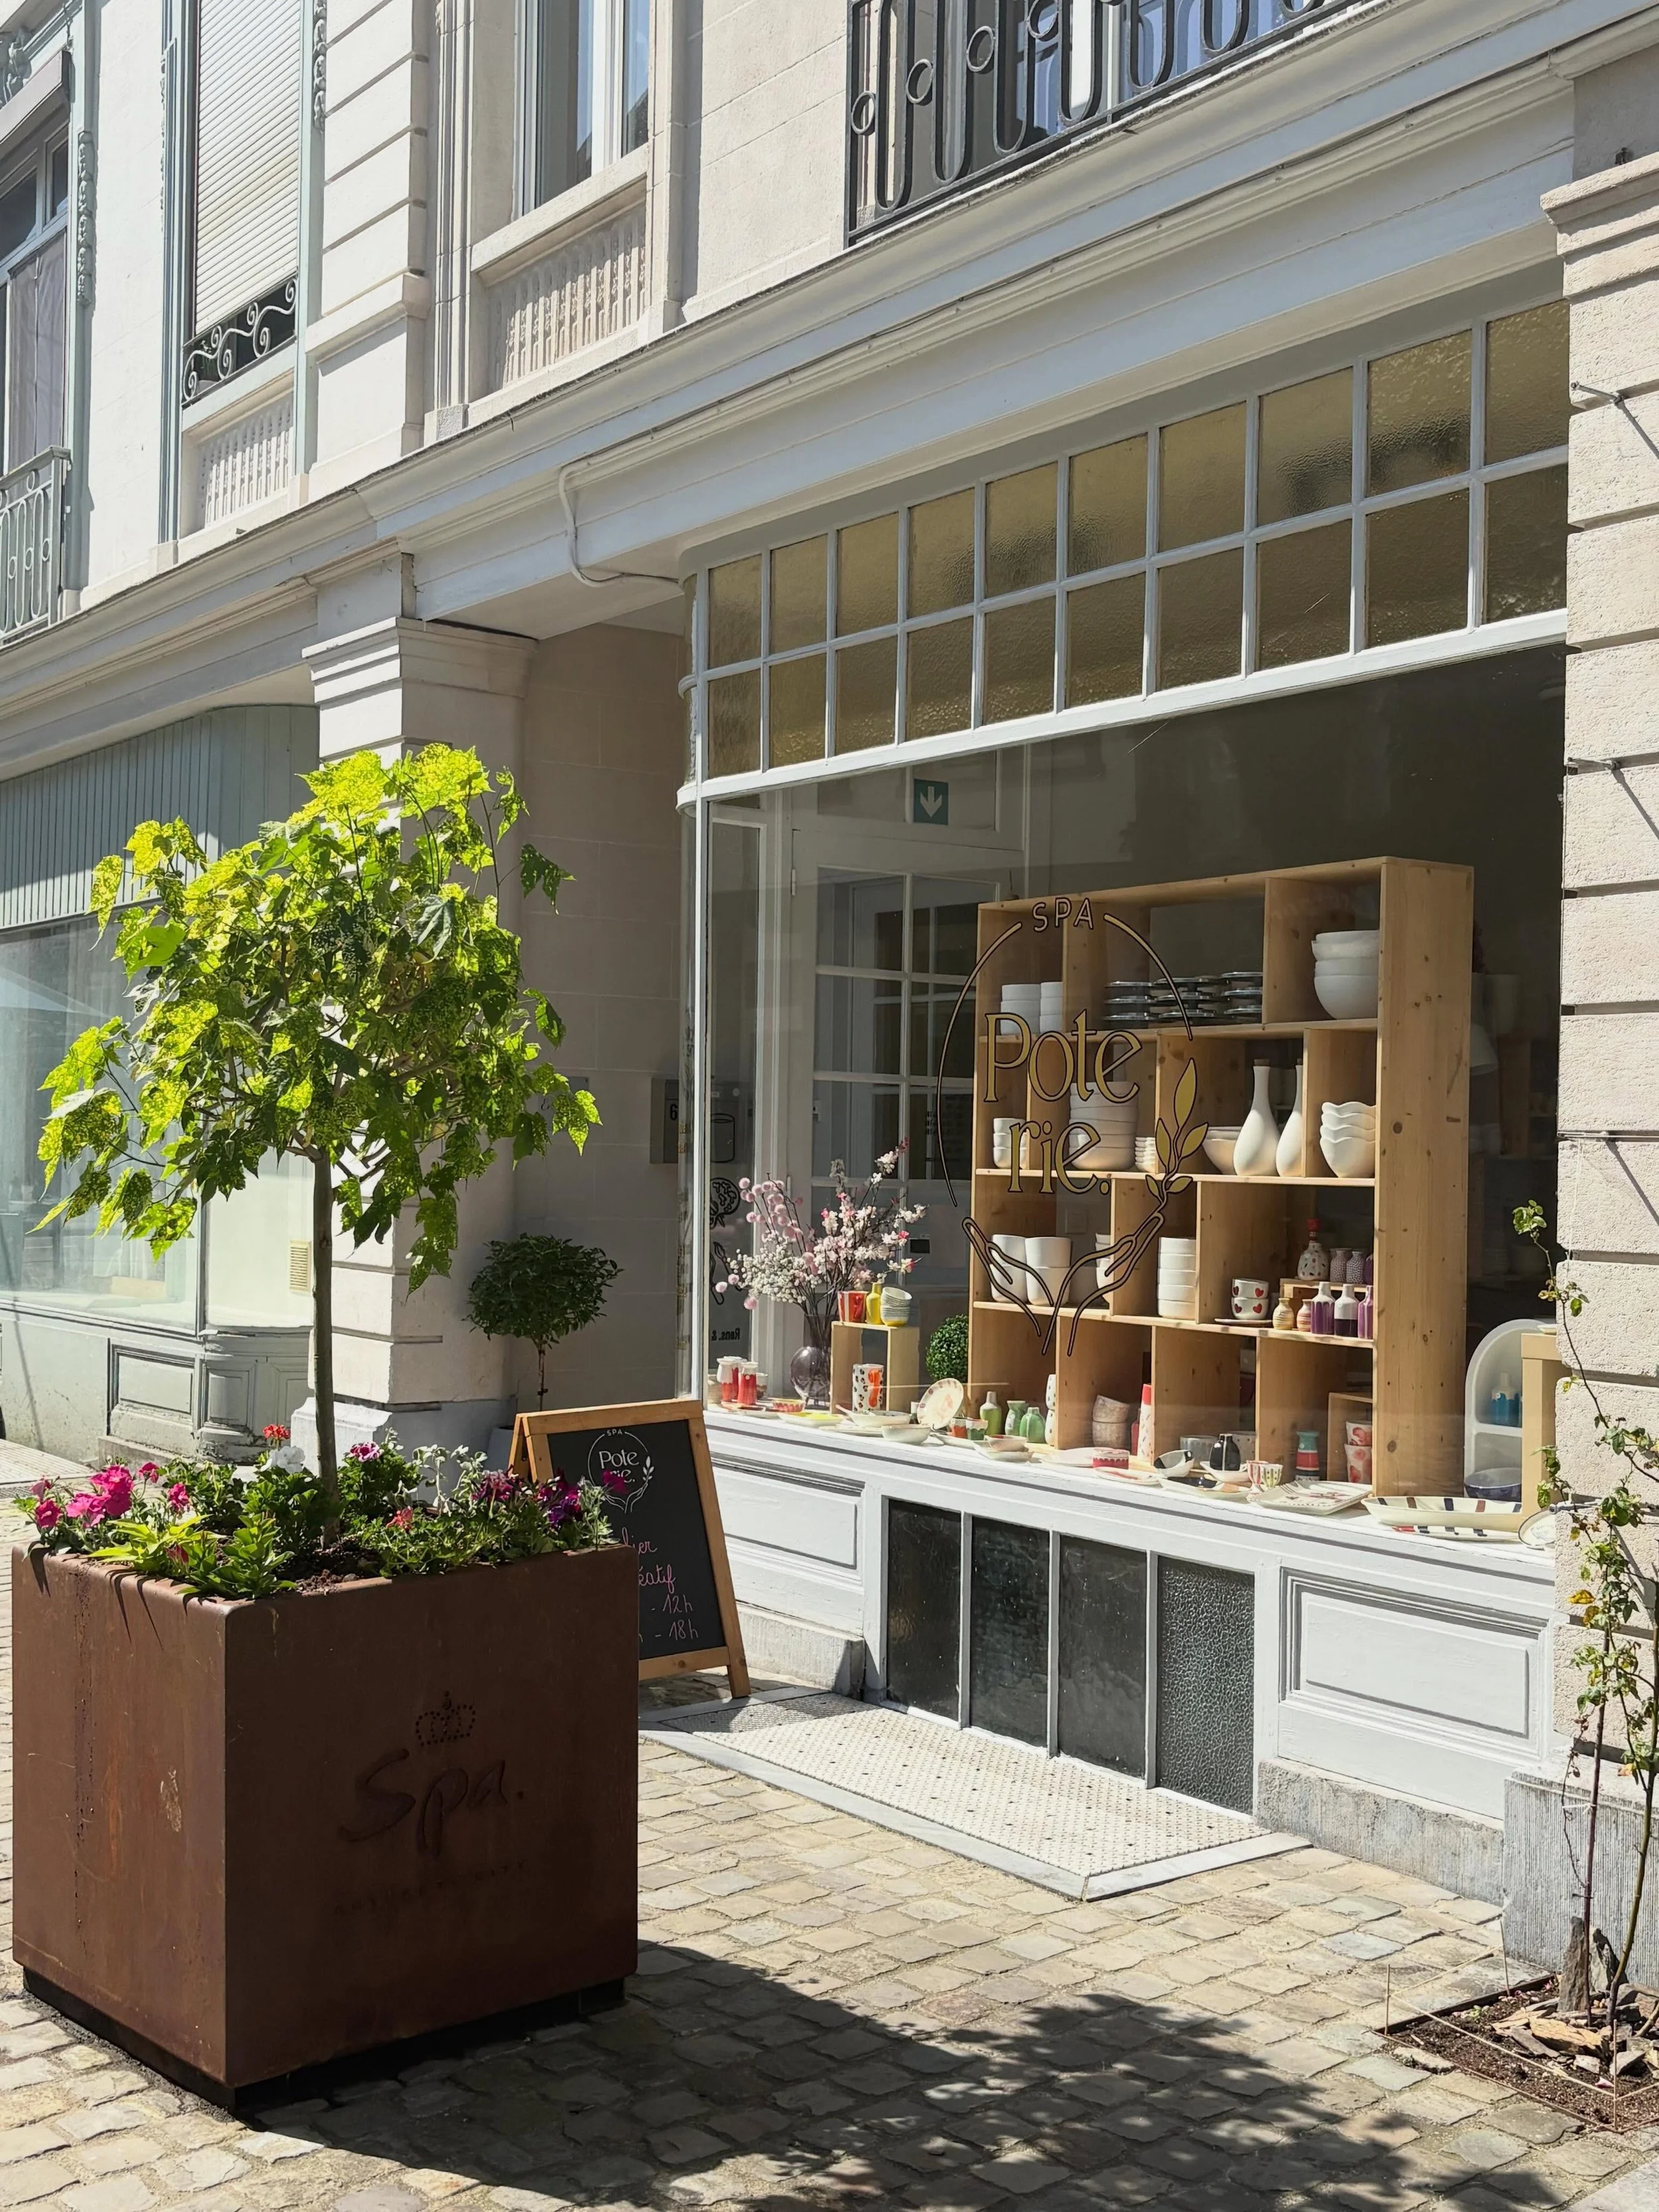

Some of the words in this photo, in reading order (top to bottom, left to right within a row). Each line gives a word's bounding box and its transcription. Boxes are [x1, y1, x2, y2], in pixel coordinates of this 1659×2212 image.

[1032, 897, 1094, 932] SPA
[983, 1009, 1142, 1104] Pote
[1007, 1120, 1110, 1195] rie.
[599, 1449, 640, 1469] Pote
